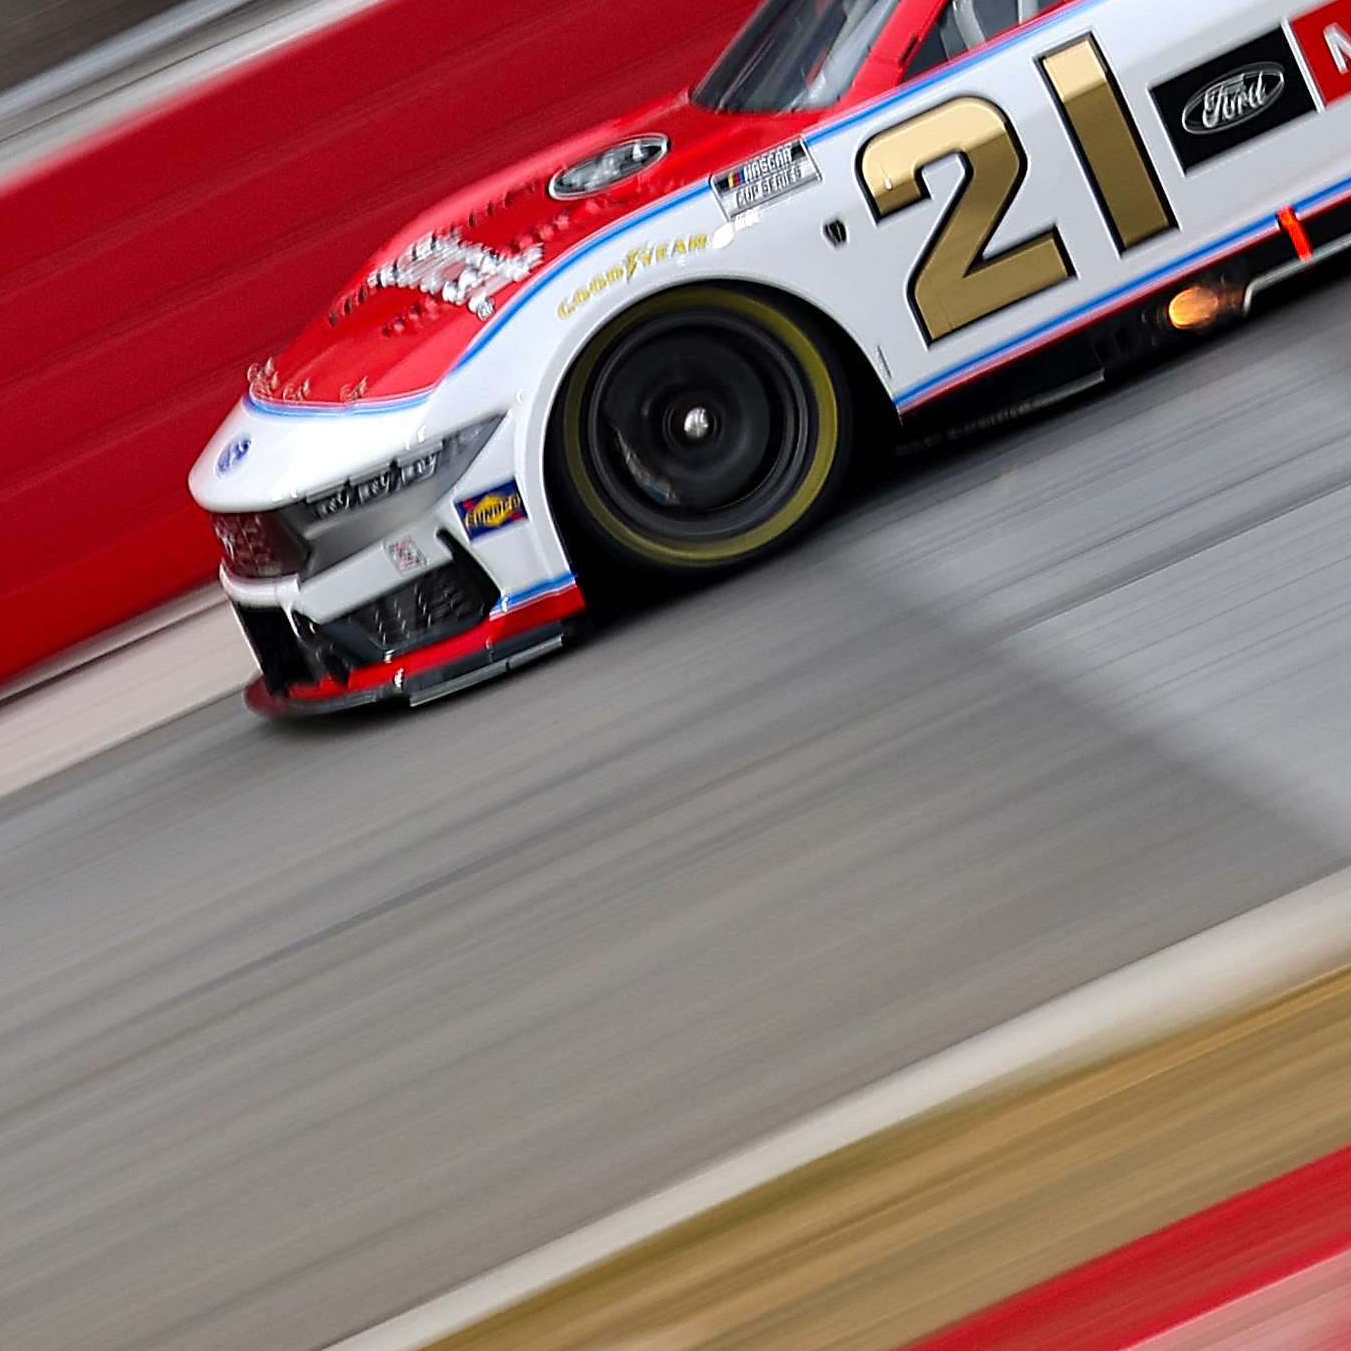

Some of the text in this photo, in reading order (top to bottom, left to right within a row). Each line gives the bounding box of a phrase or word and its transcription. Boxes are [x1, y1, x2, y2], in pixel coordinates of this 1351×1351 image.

[1199, 69, 1268, 130] Ford
[736, 166, 804, 210] CUP SERIES
[742, 143, 793, 183] NASCAR
[855, 32, 1180, 347] 21
[557, 232, 709, 320] GOODYEAR
[463, 490, 522, 529] SUNOCO
